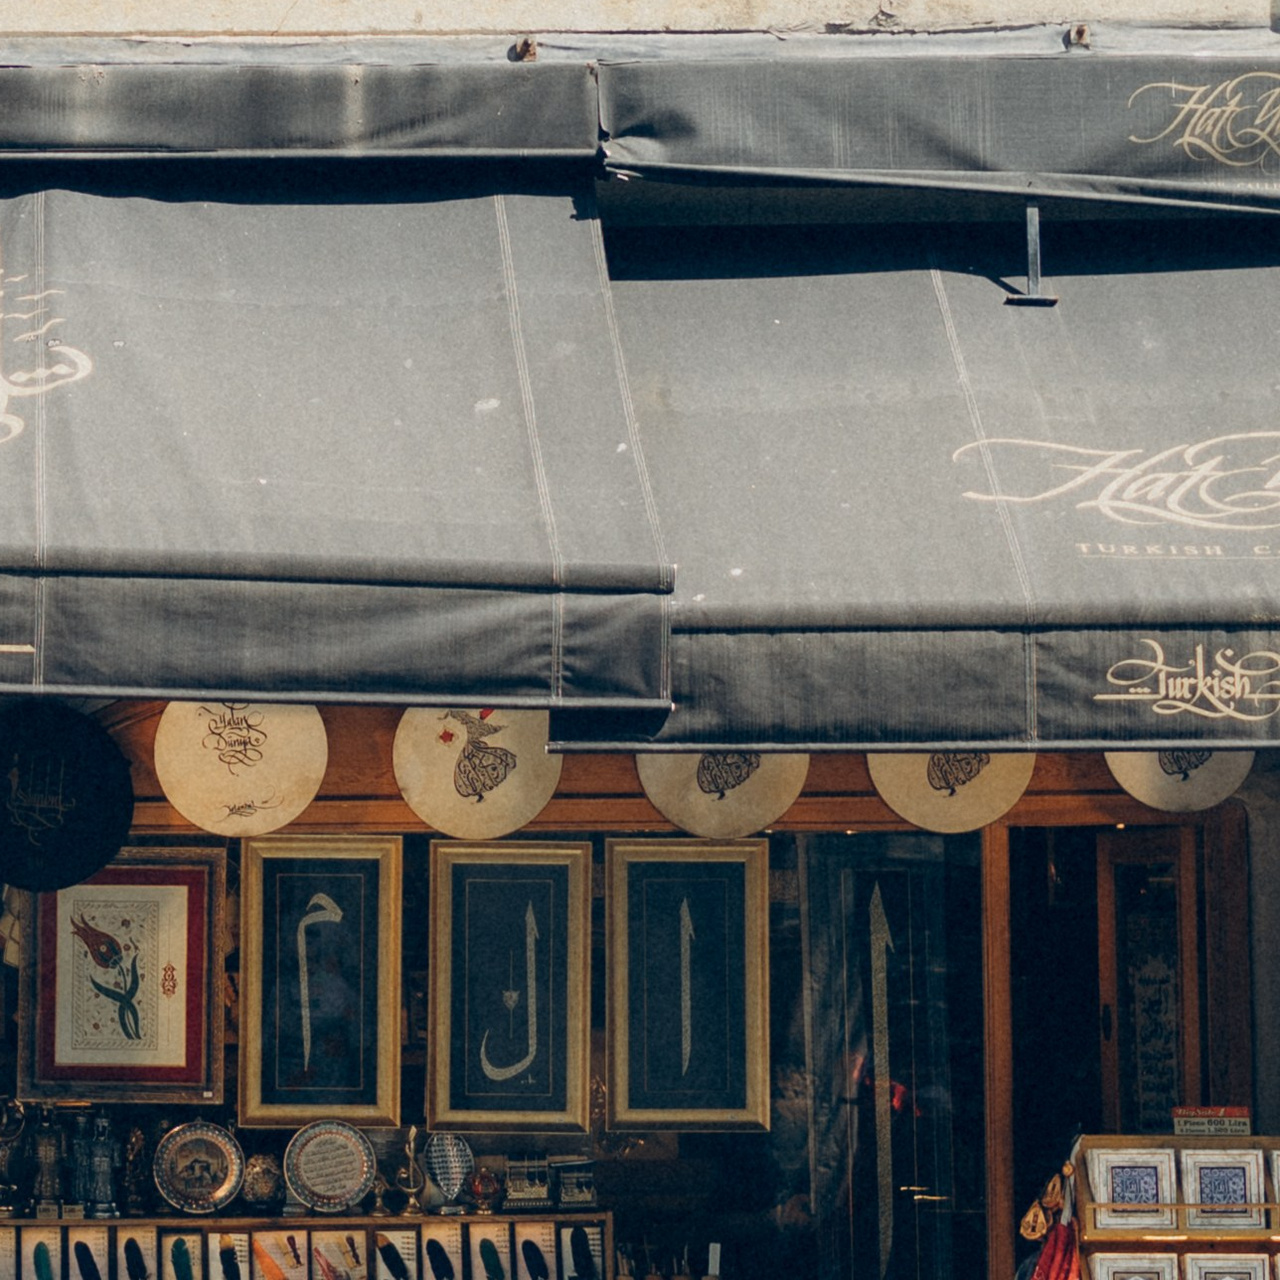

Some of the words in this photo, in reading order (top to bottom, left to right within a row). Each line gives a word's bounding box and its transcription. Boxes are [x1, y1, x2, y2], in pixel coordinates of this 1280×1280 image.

[1076, 543, 1223, 556] TURKISH
[1093, 639, 1280, 720] Turkish
[1207, 1118, 1225, 1127] 600
